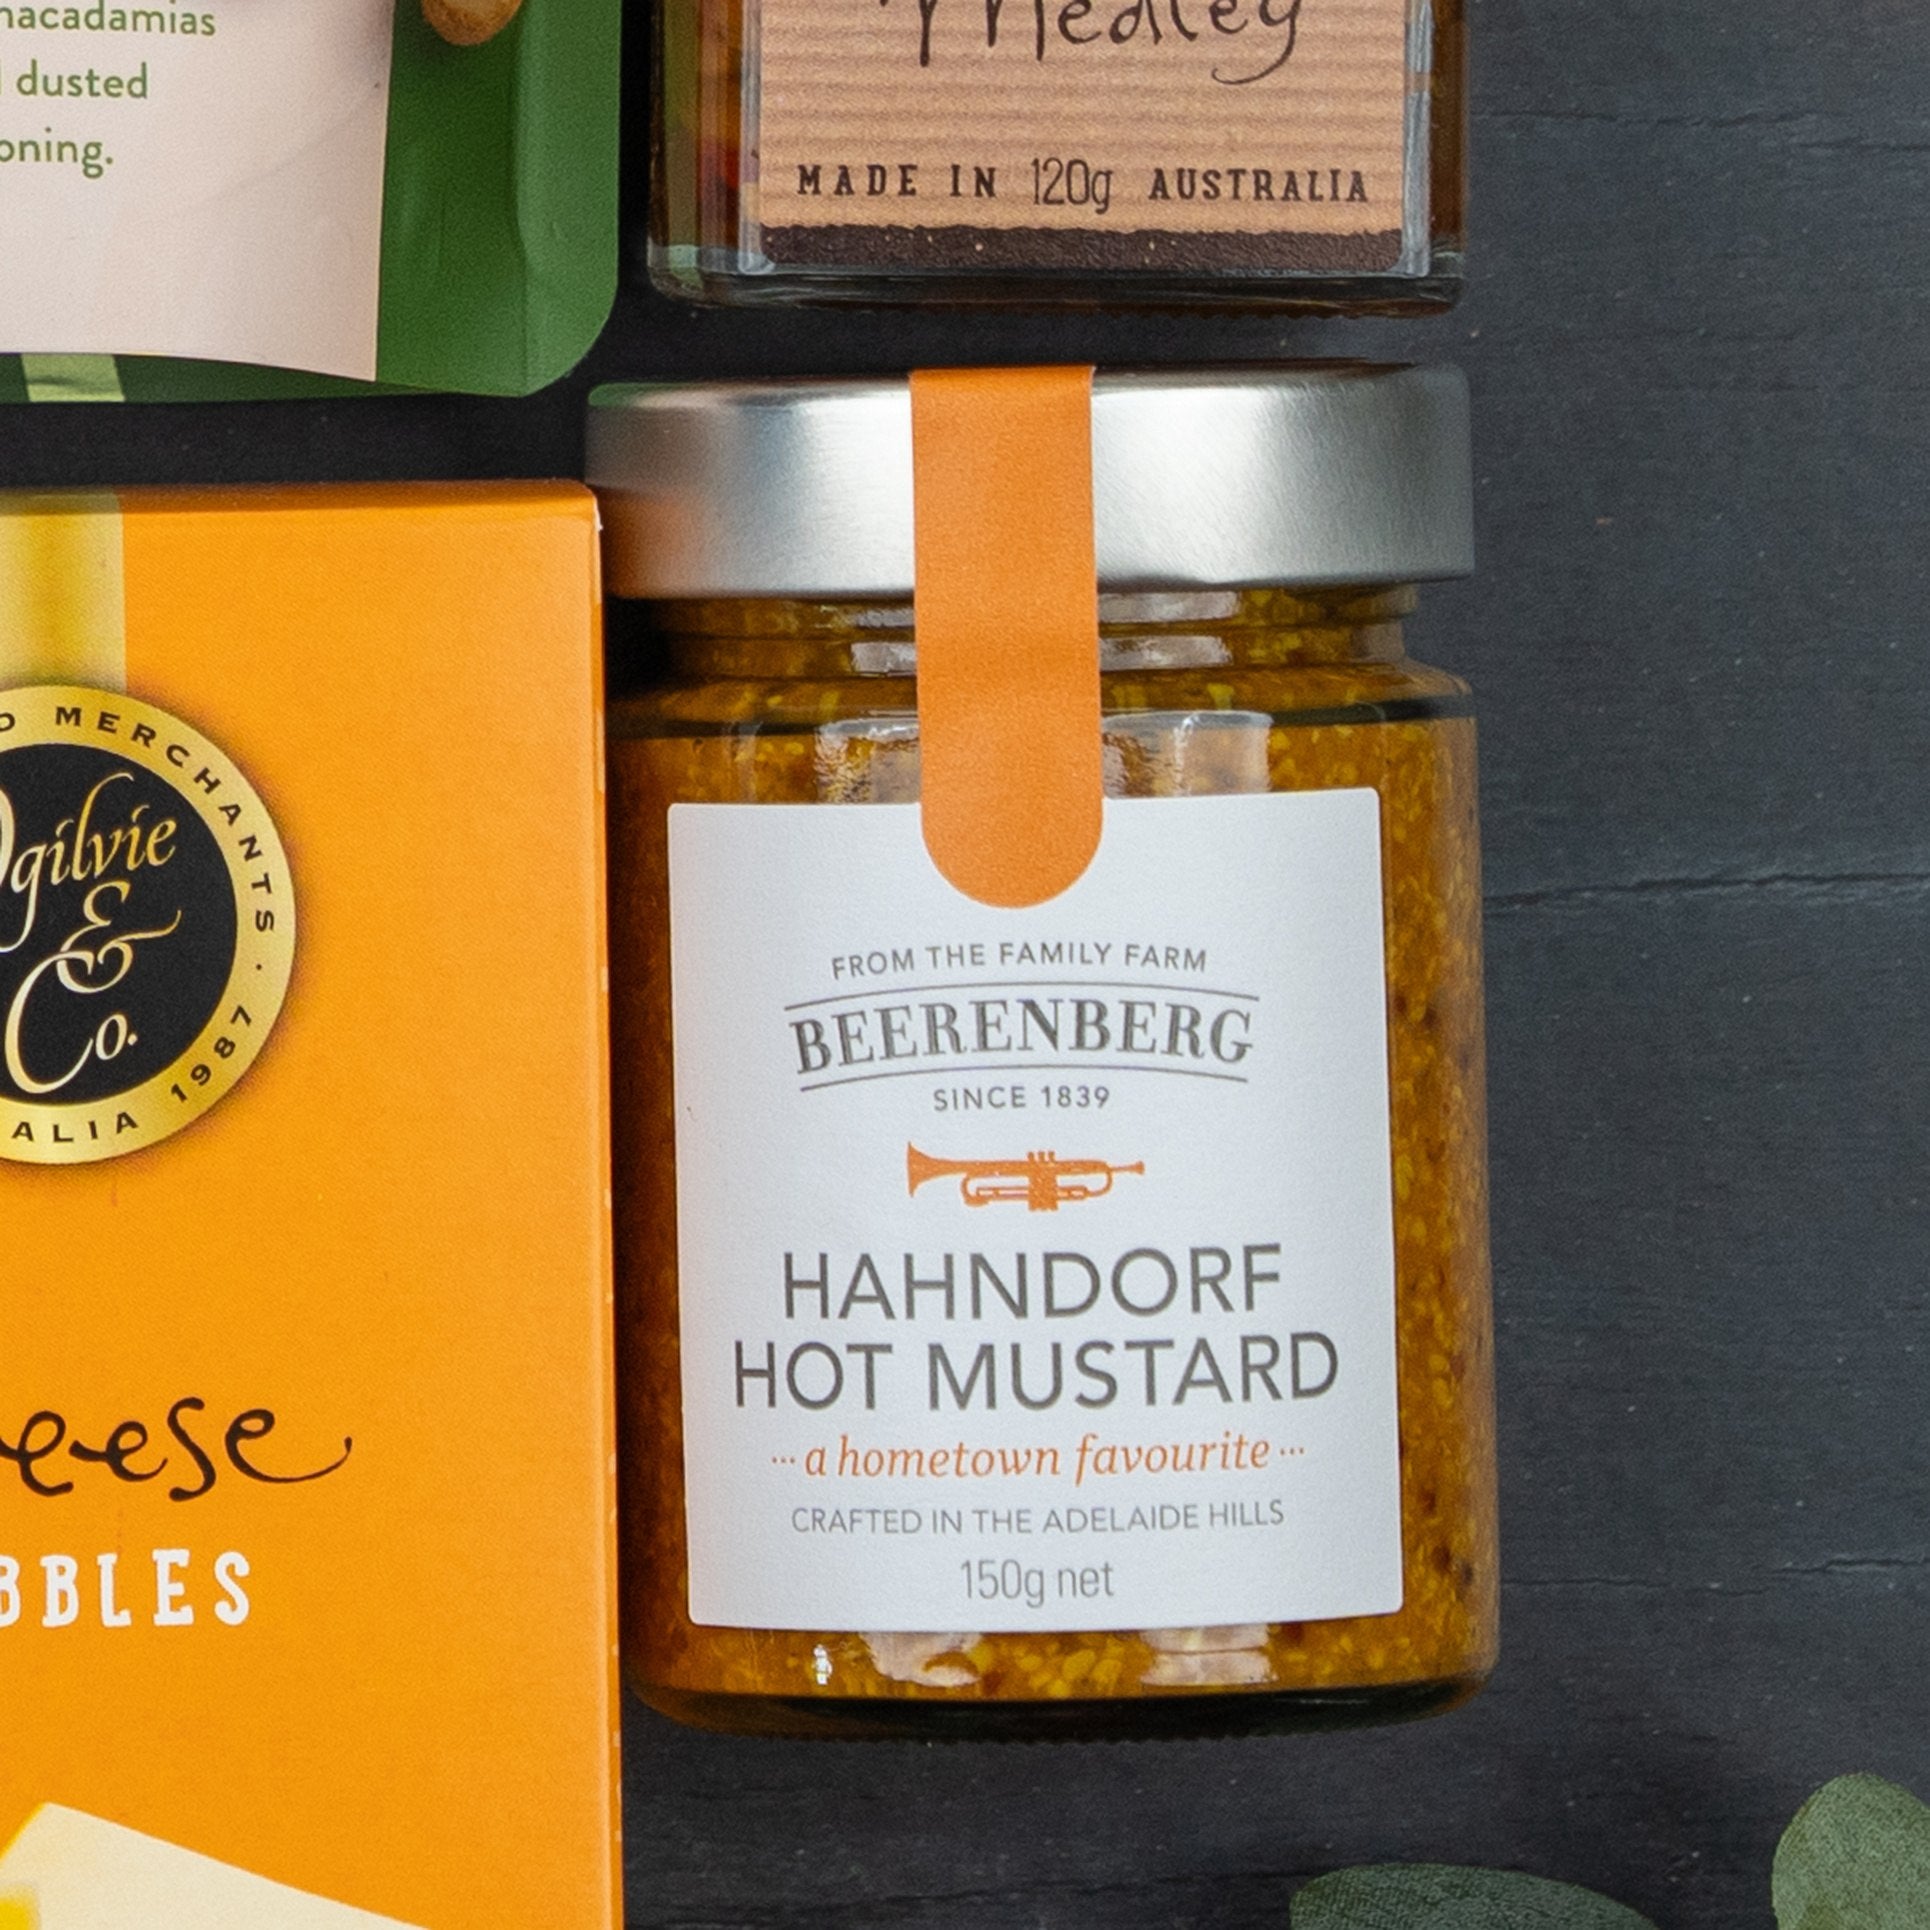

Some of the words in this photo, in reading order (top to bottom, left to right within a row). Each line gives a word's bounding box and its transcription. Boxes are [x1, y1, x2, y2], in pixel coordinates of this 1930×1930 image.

[17, 59, 147, 98] dusted
[798, 164, 917, 196] MADE
[950, 165, 995, 197] IN
[1032, 158, 1113, 214] 120g
[1149, 168, 1367, 202] AUSTRALIA
[55, 706, 275, 933] MERCHANTS
[0, 773, 175, 953] gilvie
[832, 949, 914, 980] FROM
[926, 944, 984, 968] THE
[1000, 942, 1111, 964] FAMILY
[1125, 944, 1205, 971] FARM
[6, 951, 139, 1094] Co.
[788, 998, 1254, 1075] BEERENBERG
[11, 1111, 139, 1143] ALIA
[170, 1005, 252, 1103] 1987
[934, 1086, 1025, 1111] SINCE
[1042, 1086, 1109, 1107] 1839
[784, 1243, 1280, 1319] HAHNDORF
[735, 1341, 892, 1409] HOT
[929, 1332, 1338, 1409] MUSTARD
[806, 1449, 825, 1475] a
[839, 1436, 1059, 1476] hometown
[1074, 1430, 1270, 1487] favourite
[792, 1508, 921, 1533] CRAFTED
[933, 1510, 962, 1533] IN
[972, 1509, 1031, 1533] THE
[1043, 1505, 1198, 1532] ADELAIDE
[1210, 1499, 1284, 1526] HILLS
[962, 1560, 1044, 1608] 150g
[1058, 1563, 1113, 1597] net
